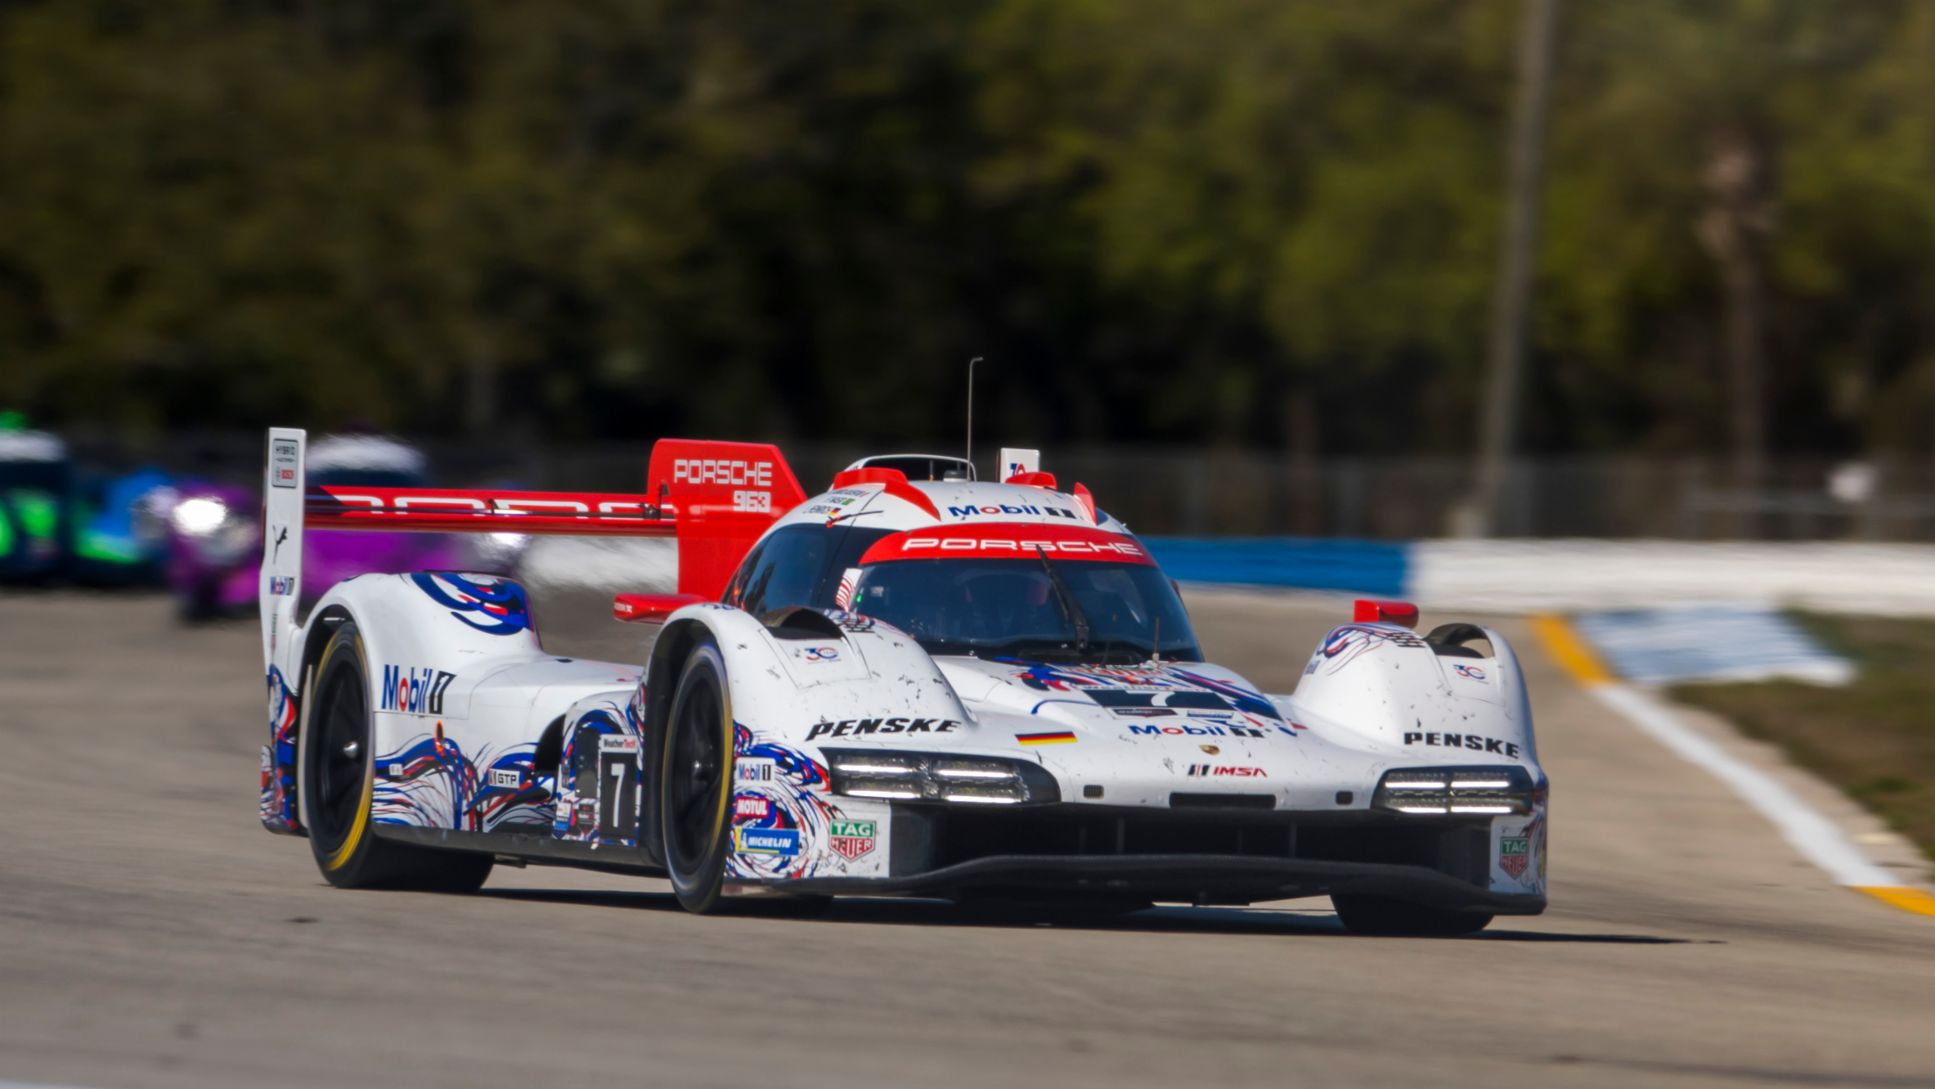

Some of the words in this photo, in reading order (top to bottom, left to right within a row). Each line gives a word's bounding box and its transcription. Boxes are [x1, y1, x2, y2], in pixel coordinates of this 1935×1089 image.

[673, 458, 773, 487] PORSCHE
[733, 490, 771, 513] 963
[947, 504, 1041, 518] Mobil
[902, 537, 1144, 556] PORSCHE
[381, 664, 433, 713] Mobil
[431, 671, 454, 714] 1
[804, 717, 962, 742] PENSKE
[1127, 724, 1227, 737] Mobil
[1403, 732, 1520, 760] PENSKE
[497, 773, 517, 785] GTP
[738, 763, 761, 782] Mobil
[763, 764, 771, 781] 1
[1212, 766, 1268, 778] IMSA
[611, 763, 626, 828] 7
[737, 799, 768, 815] MOTUL
[832, 822, 872, 836] TAG
[748, 836, 792, 849] MICHELIN
[831, 837, 874, 862] HEUER
[1503, 840, 1527, 854] TAG
